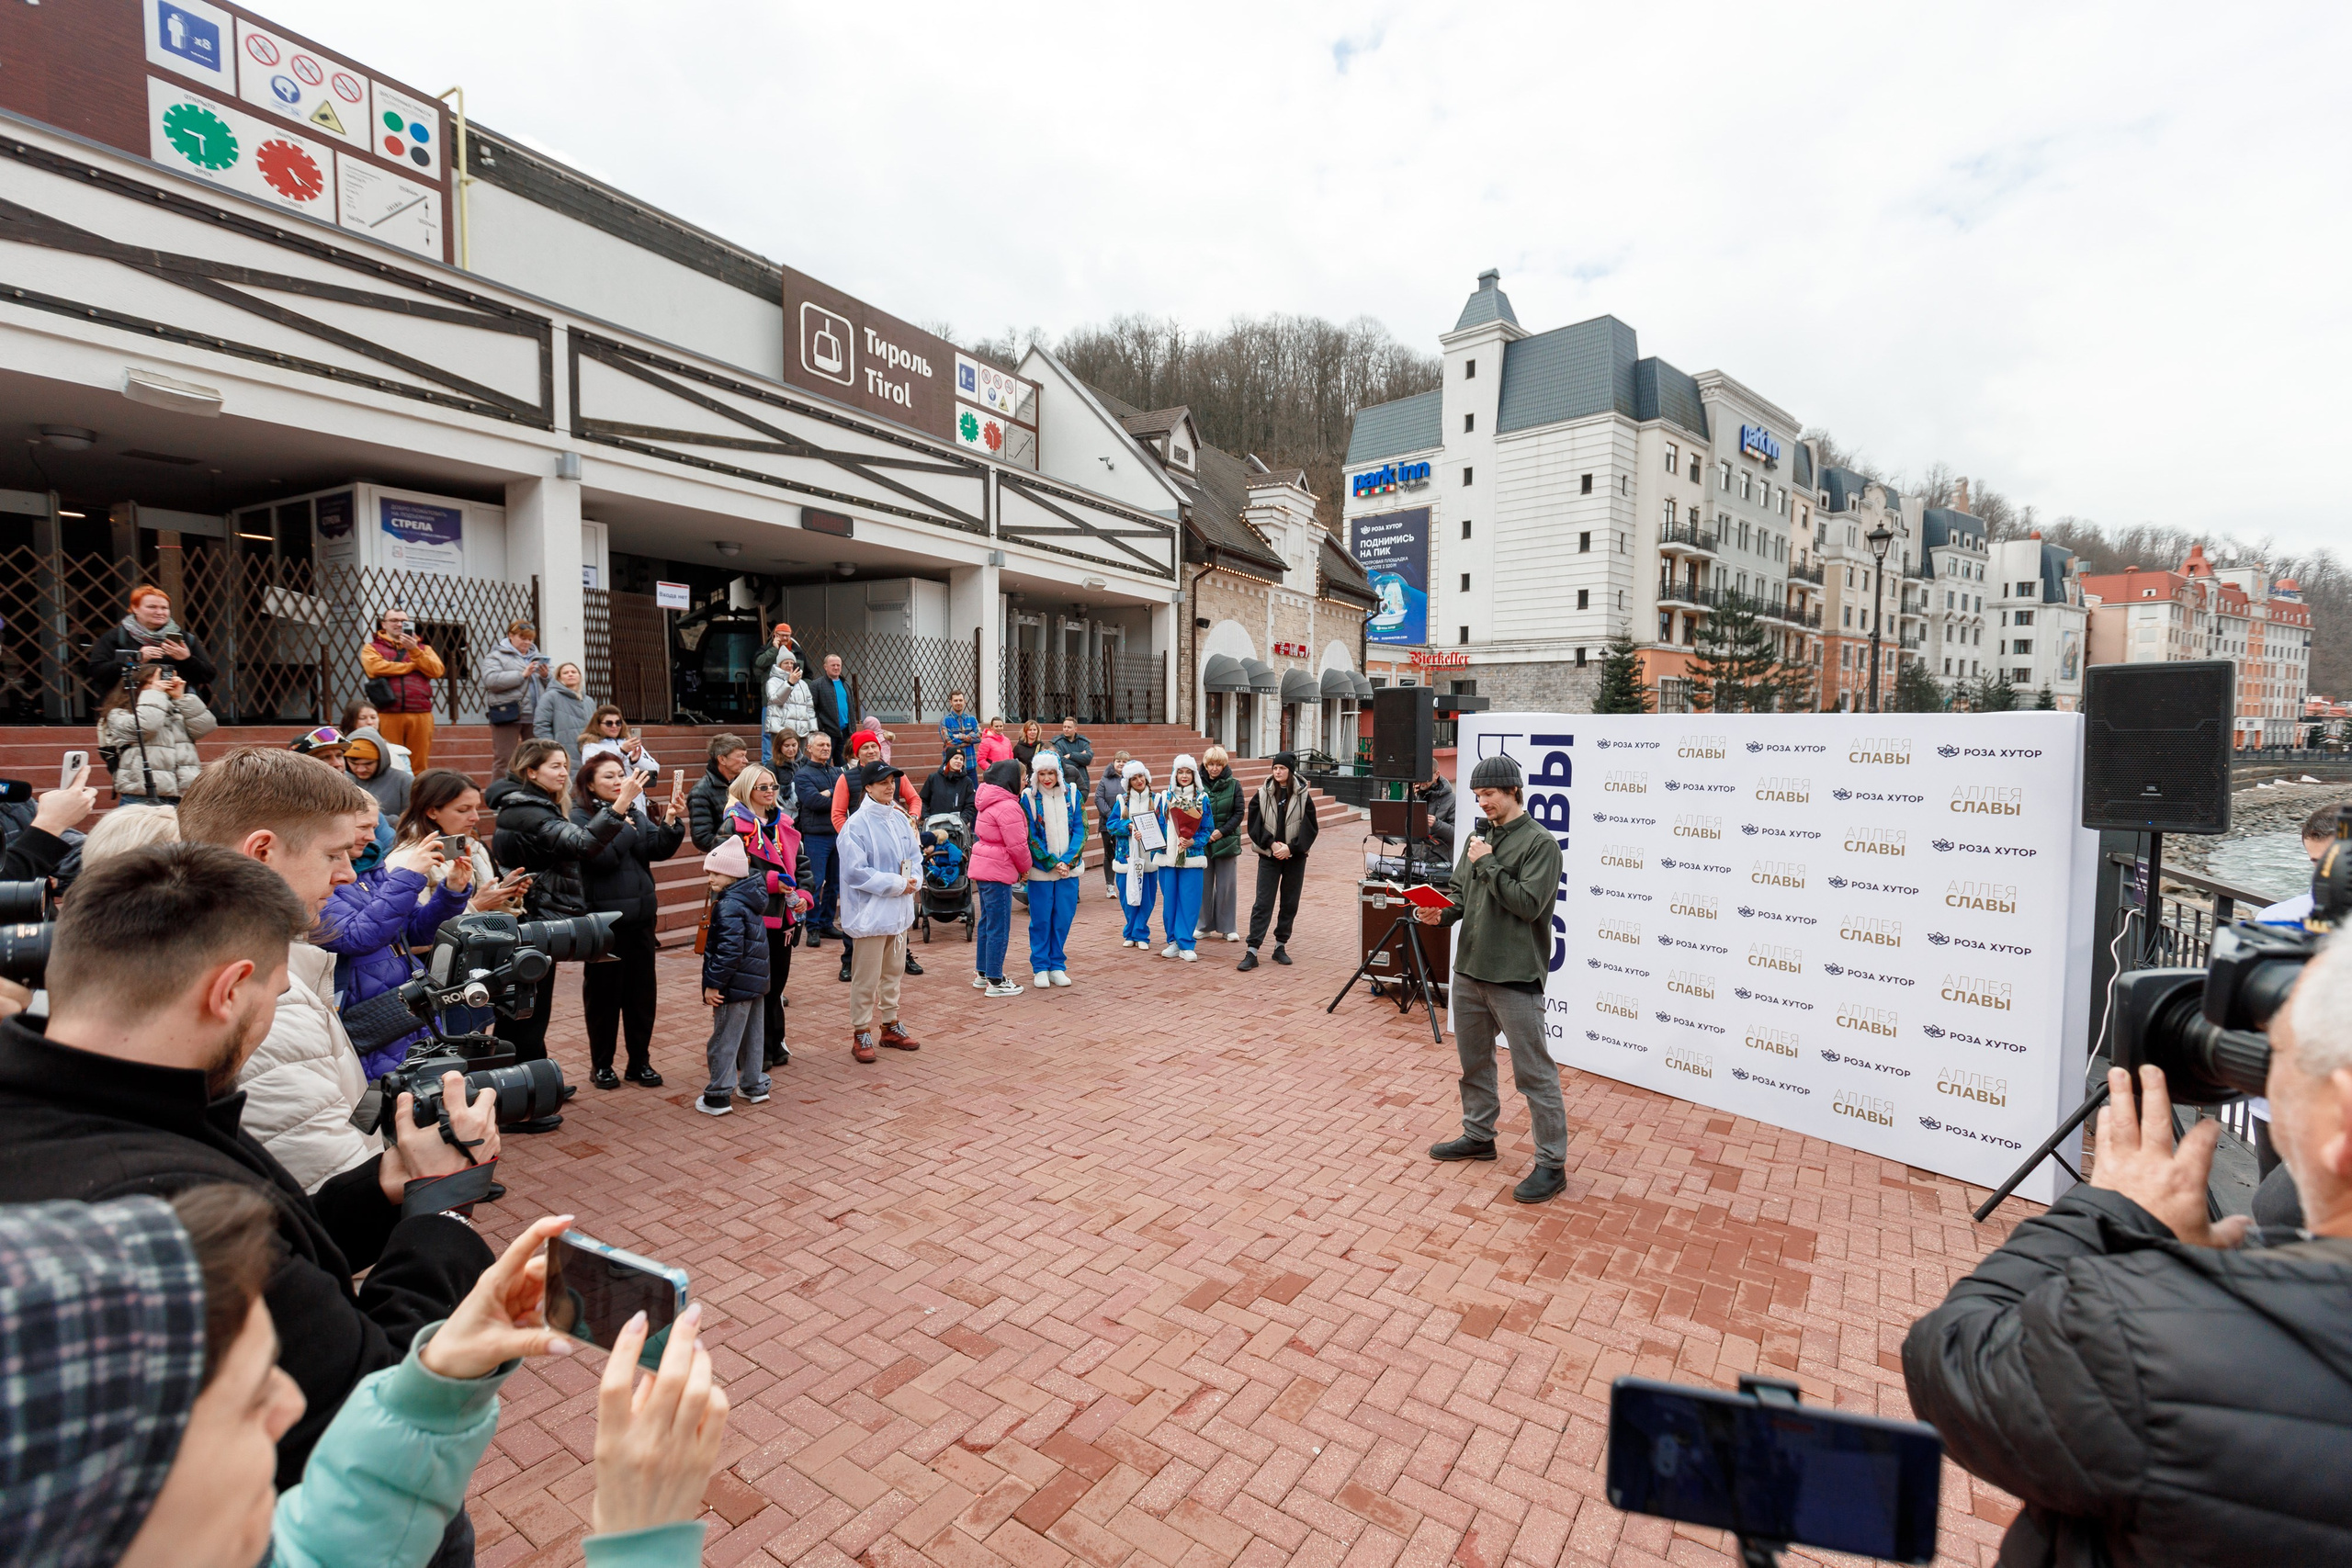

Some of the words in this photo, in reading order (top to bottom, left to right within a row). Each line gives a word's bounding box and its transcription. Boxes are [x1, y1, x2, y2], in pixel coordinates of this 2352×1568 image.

[864, 326, 933, 378] Тироль
[864, 367, 912, 409] Tirol
[1352, 465, 1396, 497] park
[1398, 461, 1430, 481] inn
[391, 518, 434, 533] СТРЕЛА
[1385, 523, 1403, 531] ХУТОР
[1360, 533, 1415, 548] ПОДНИМИСЬ
[1360, 549, 1373, 558] НА
[1374, 547, 1392, 557] ПИК
[659, 591, 677, 599] Входа
[1408, 651, 1470, 668] Bierkeller
[1612, 740, 1634, 749] РОЗА
[1634, 741, 1660, 750] ХУТОР
[1678, 736, 1727, 749] АЛЛЕЯ
[1766, 744, 1792, 752] РОЗА
[1793, 745, 1826, 753] ХУТОР
[1849, 738, 1912, 751] АЛЛЕЯ
[1678, 748, 1725, 760] СЛАВЫ
[1849, 751, 1910, 765] СЛАВЫ
[1963, 748, 1996, 757] РОЗА
[1999, 749, 2042, 759] ХУТОР
[1604, 771, 1648, 783] АЛЛЕЯ
[1756, 777, 1811, 791] АЛЛЕЯ
[1604, 782, 1647, 794] СЛАВЫ
[1682, 783, 1705, 792] РОЗА
[1706, 784, 1736, 793] ХУТОР
[1951, 785, 2022, 802] АЛЛЕЯ
[1755, 790, 1809, 804] СЛАВЫ
[1855, 792, 1884, 801] РОЗА
[1886, 794, 1924, 804] ХУТОР
[1950, 800, 2021, 816] СЛАВЫ
[1609, 815, 1629, 824] РОЗА
[1630, 817, 1657, 826] ХУТОР
[1673, 814, 1723, 829] АЛЛЕЯ
[1673, 826, 1721, 840] СЛАВЫ
[1761, 828, 1787, 837] РОЗА
[1789, 829, 1822, 840] ХУТОР
[1844, 827, 1906, 843] АЛЛЕЯ
[1600, 844, 1645, 859] АЛЛЕЯ
[1844, 840, 1905, 857] СЛАВЫ
[1958, 843, 1991, 854] РОЗА
[1994, 846, 2037, 858] ХУТОР
[1600, 855, 1644, 870] СЛАВЫ
[1679, 862, 1702, 871] РОЗА
[1702, 863, 1732, 874] ХУТОР
[1751, 860, 1806, 877] АЛЛЕЯ
[1751, 873, 1805, 889] СЛАВЫ
[1851, 880, 1880, 892] РОЗА
[1882, 884, 1919, 896] ХУТОР
[1945, 880, 2018, 897] АЛЛЕЯ
[1605, 889, 1626, 898] РОЗА
[1626, 892, 1653, 902] ХУТОР
[1669, 892, 1719, 908] АЛЛЕЯ
[1945, 894, 2016, 914] СЛАВЫ
[1669, 903, 1717, 920] СЛАВЫ
[1758, 910, 1783, 921] РОЗА
[1784, 914, 1817, 926] ХУТОР
[1598, 918, 1642, 934] АЛЛЕЯ
[1839, 915, 1903, 935] АЛЛЕЯ
[1598, 929, 1640, 945] СЛАВЫ
[1839, 928, 1901, 948] СЛАВЫ
[1675, 939, 1698, 950] РОЗА
[1699, 943, 1728, 954] ХУТОР
[1747, 942, 1803, 962] АЛЛЕЯ
[1953, 938, 1986, 951] РОЗА
[1989, 942, 2032, 956] ХУТОР
[1603, 963, 1623, 973] РОЗА
[1624, 966, 1650, 978] ХУТОР
[1747, 954, 1802, 974] СЛАВЫ
[1667, 969, 1715, 988] АЛЛЕЯ
[1847, 968, 1876, 981] РОЗА
[1878, 974, 1916, 987] ХУТОР
[1941, 974, 2012, 995] АЛЛЕЯ
[1667, 981, 1714, 999] СЛАВЫ
[1596, 991, 1639, 1010] АЛЛЕЯ
[1754, 993, 1780, 1005] РОЗА
[1781, 998, 1815, 1011] ХУТОР
[1940, 987, 2011, 1011] СЛАВЫ
[1596, 1001, 1638, 1021] СЛАВЫ
[1837, 1002, 1898, 1025] АЛЛЕЯ
[1673, 1016, 1696, 1028] РОЗА
[1697, 1021, 1725, 1034] ХУТОР
[1836, 1015, 1897, 1038] СЛАВЫ
[1745, 1024, 1800, 1046] АЛЛЕЯ
[1950, 1032, 1982, 1045] РОЗА
[1984, 1038, 2027, 1054] ХУТОР
[1601, 1035, 1622, 1047] РОЗА
[1623, 1041, 1648, 1053] ХУТОР
[1745, 1036, 1798, 1058] СЛАВЫ
[1665, 1045, 1713, 1067] АЛЛЕЯ
[1665, 1057, 1713, 1078] СЛАВЫ
[1843, 1055, 1872, 1070] РОЗА
[1874, 1063, 1911, 1077] ХУТОР
[1751, 1074, 1777, 1088] РОЗА
[1779, 1081, 1811, 1096] ХУТОР
[1937, 1066, 2007, 1091] АЛЛЕЯ
[1832, 1089, 1894, 1111] АЛЛЕЯ
[1937, 1080, 2007, 1108] СЛАВЫ
[1832, 1101, 1894, 1128] СЛАВЫ
[1945, 1124, 1977, 1140] РОЗА
[1980, 1133, 2022, 1151] ХУТОР
